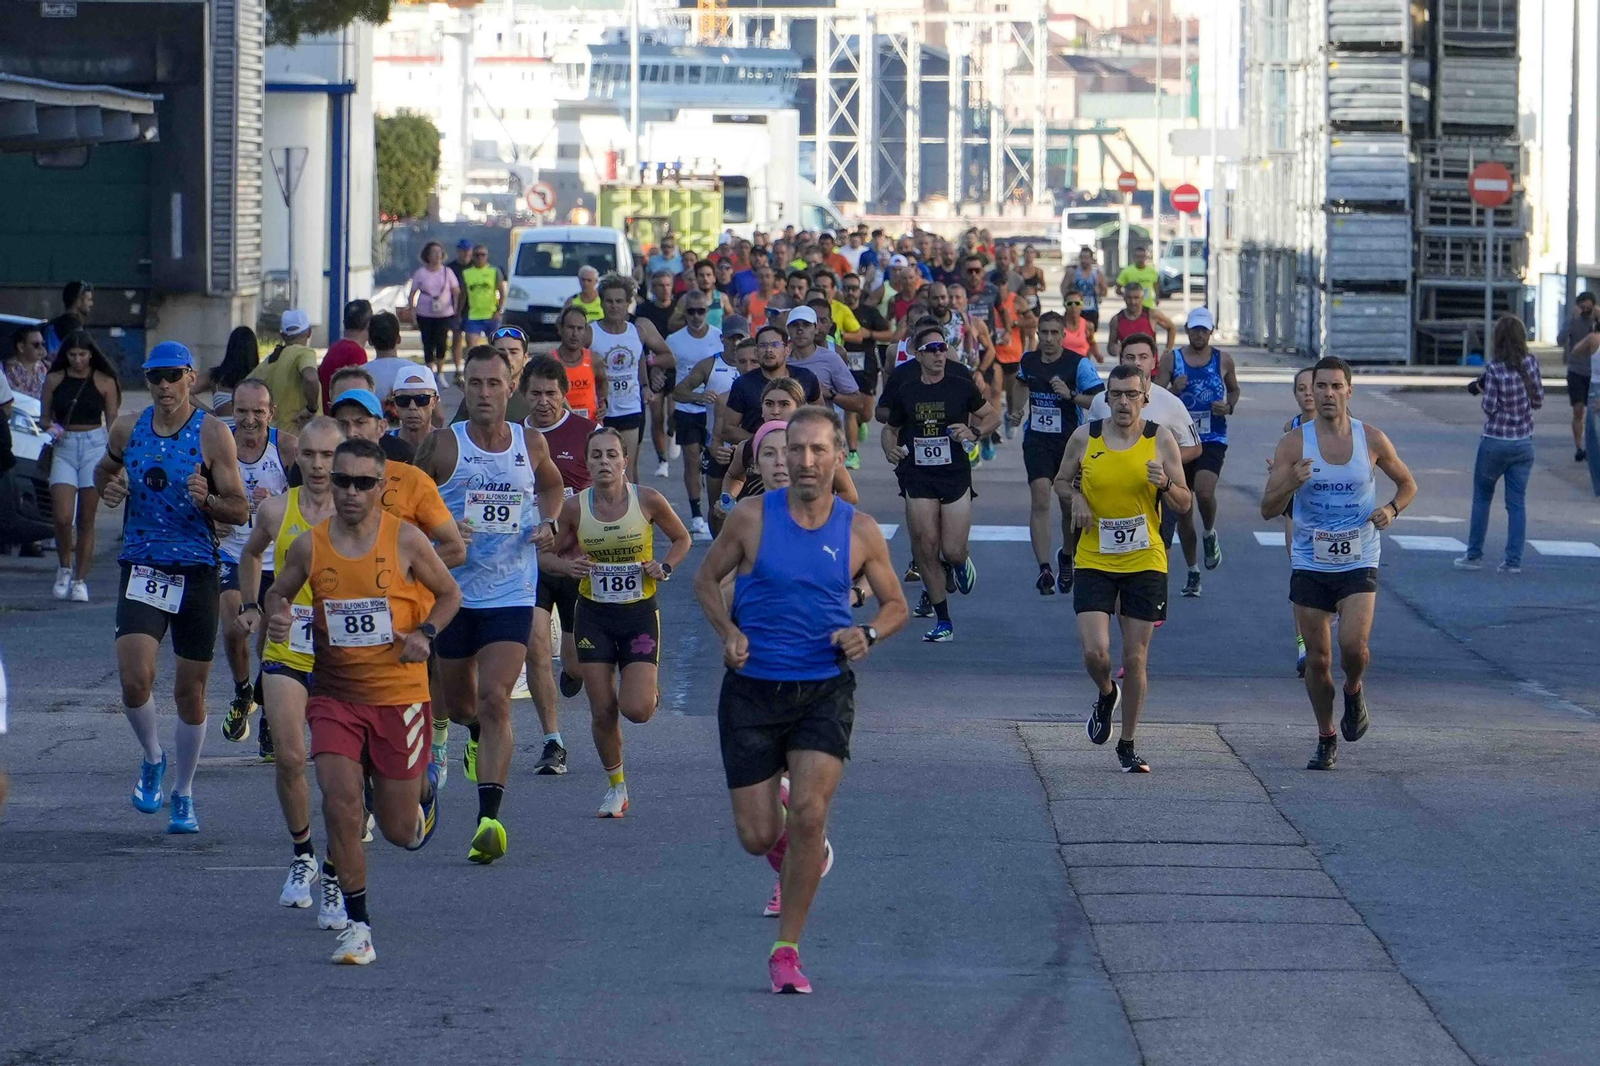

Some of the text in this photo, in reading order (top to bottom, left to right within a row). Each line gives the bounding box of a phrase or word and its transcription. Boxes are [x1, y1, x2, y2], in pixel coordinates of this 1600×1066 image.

[614, 381, 628, 391] 99
[1038, 415, 1053, 426] 45
[923, 428, 939, 436] LAST
[924, 446, 942, 458] 60
[486, 492, 508, 500] ALFONSO
[483, 504, 510, 522] 89
[1114, 528, 1137, 543] 97
[1328, 541, 1352, 555] 48
[145, 580, 169, 599] 81
[599, 575, 637, 592] 186
[344, 600, 369, 610] ALFONSO
[344, 614, 376, 634] 88
